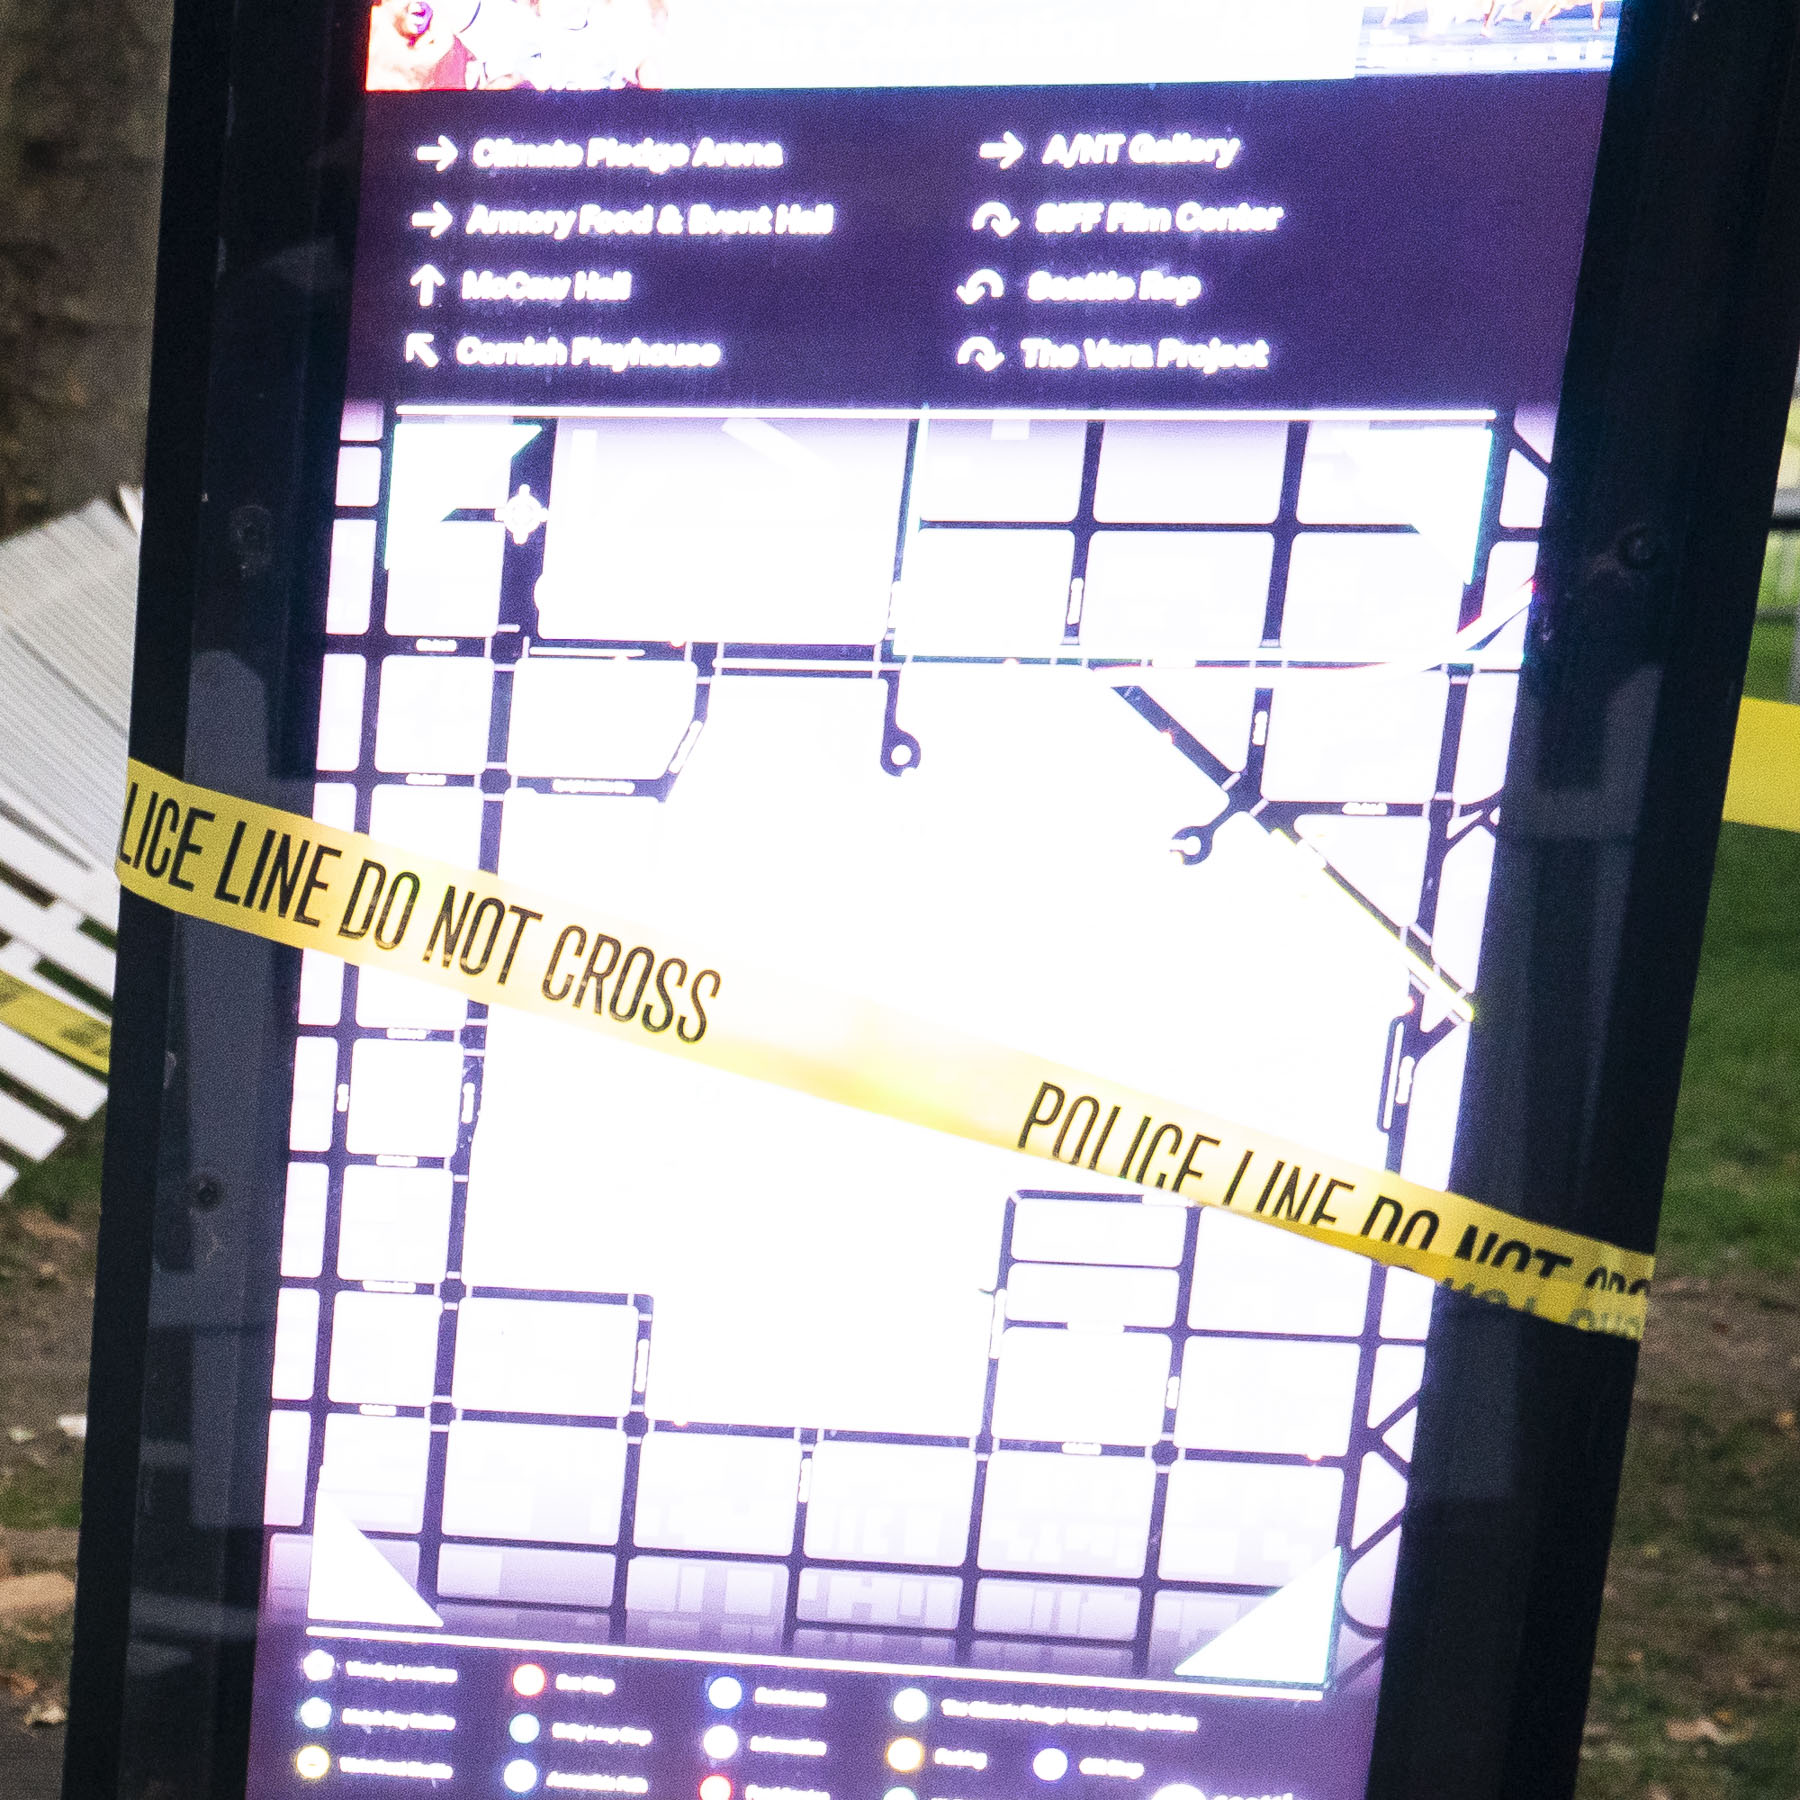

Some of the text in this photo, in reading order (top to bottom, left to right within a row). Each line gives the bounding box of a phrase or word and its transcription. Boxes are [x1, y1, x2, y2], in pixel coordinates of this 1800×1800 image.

[578, 204, 654, 235] Food
[656, 204, 684, 234] &
[774, 204, 834, 235] Hall
[574, 270, 632, 301] Hall
[1020, 338, 1080, 368] The
[1155, 337, 1270, 375] Project
[213, 820, 343, 928] LINE
[337, 858, 421, 951] DO
[422, 884, 544, 986] NOT
[541, 924, 722, 1044] CROSS
[1015, 1081, 1221, 1194] POLICE
